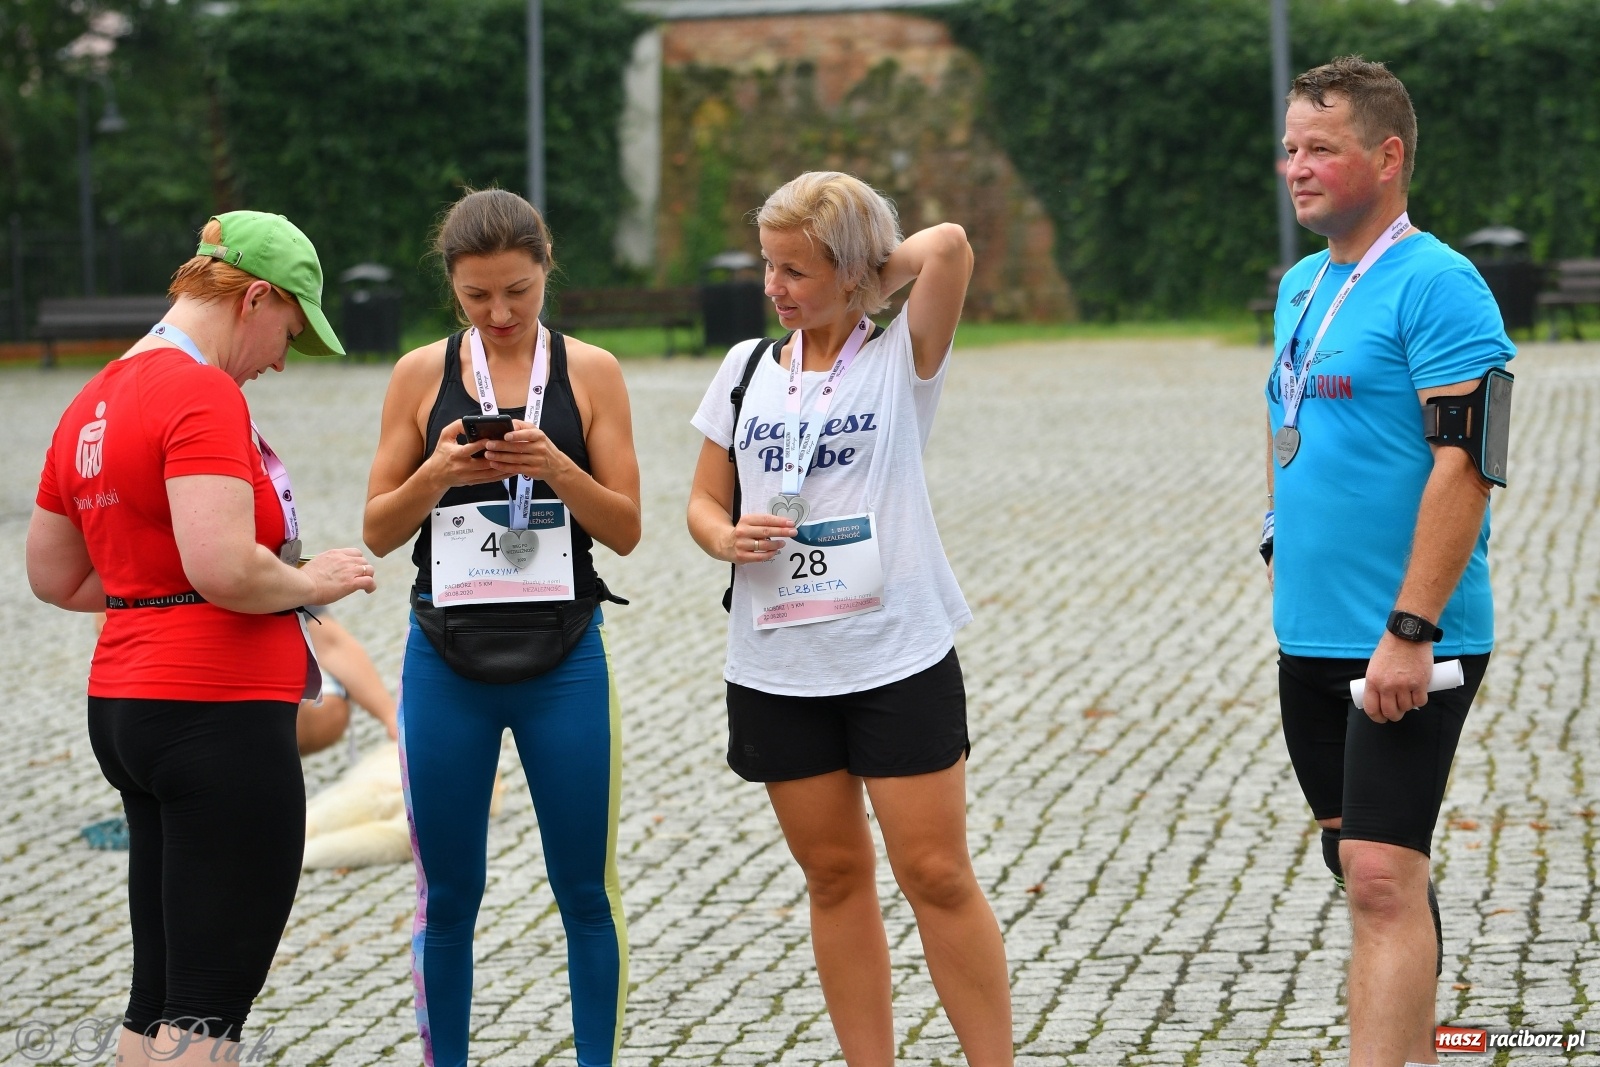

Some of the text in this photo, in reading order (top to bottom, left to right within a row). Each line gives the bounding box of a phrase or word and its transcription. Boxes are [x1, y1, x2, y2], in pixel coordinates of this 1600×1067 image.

[1317, 375, 1353, 400] RUN
[96, 488, 119, 508] Polski
[480, 532, 500, 557] 4
[468, 568, 519, 577] KATARZYNA
[789, 550, 828, 580] 28
